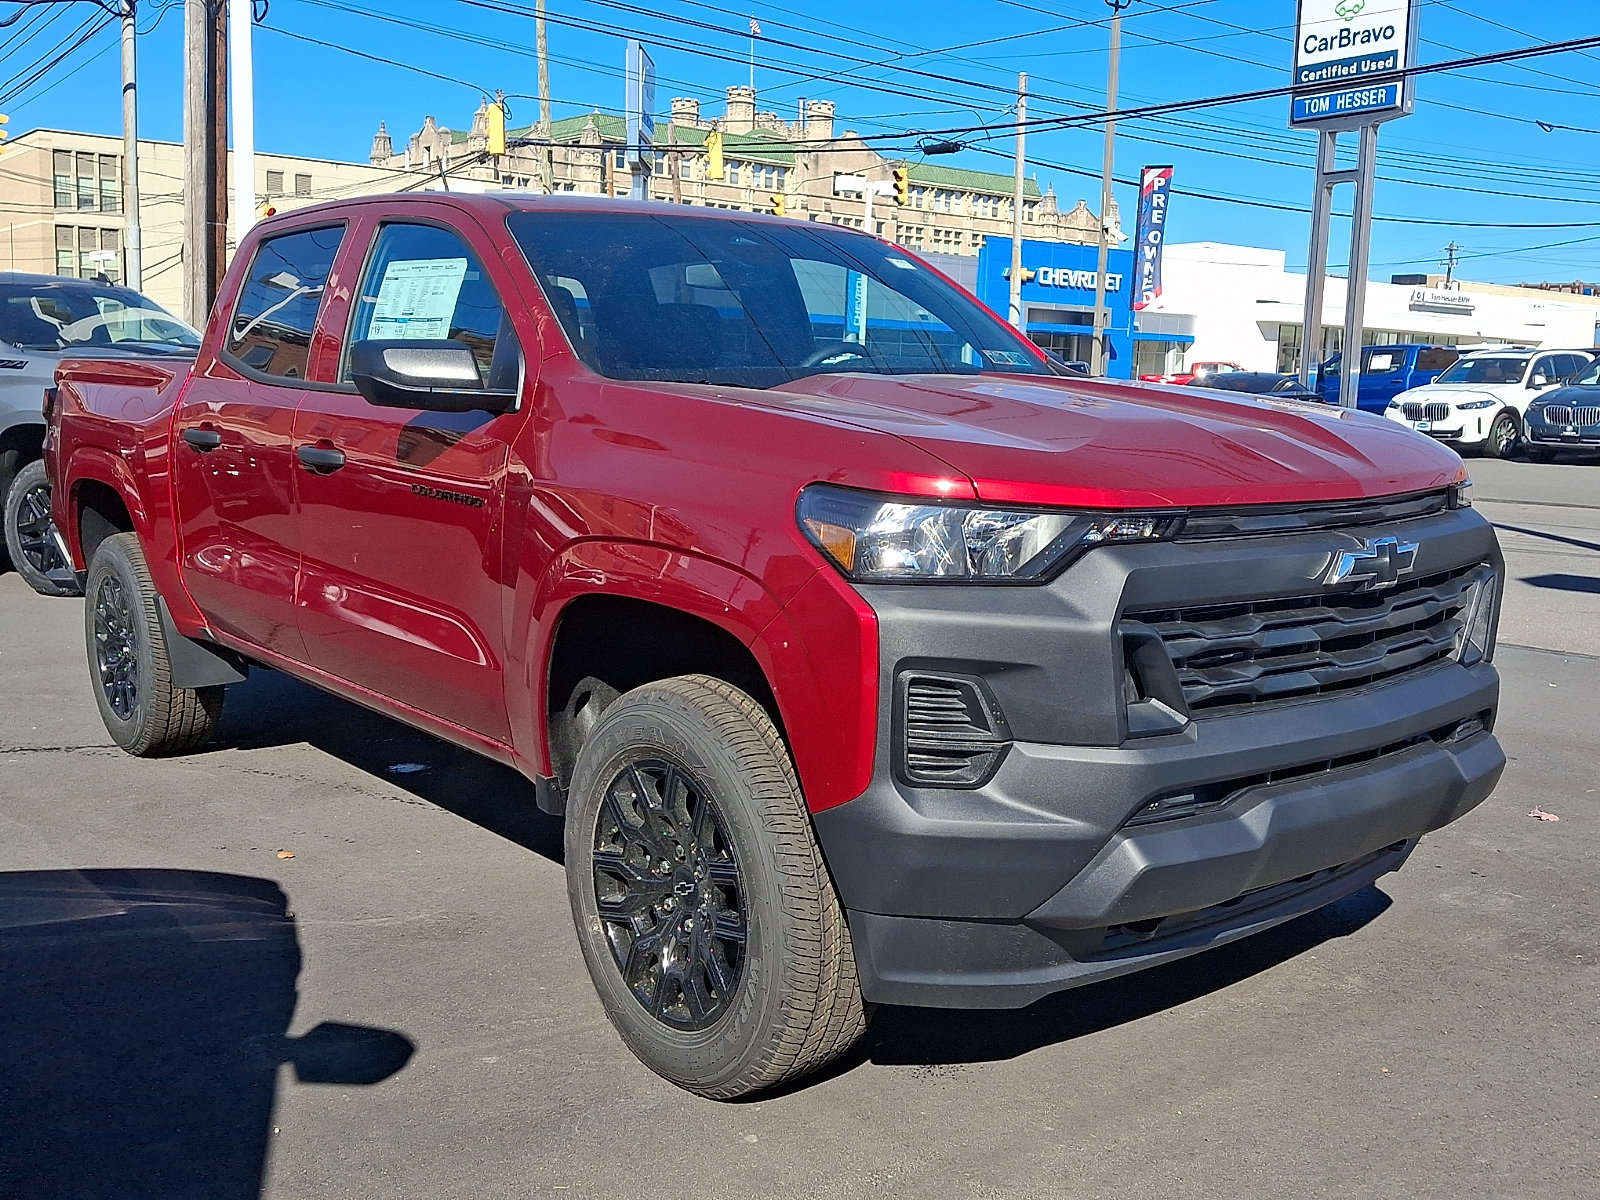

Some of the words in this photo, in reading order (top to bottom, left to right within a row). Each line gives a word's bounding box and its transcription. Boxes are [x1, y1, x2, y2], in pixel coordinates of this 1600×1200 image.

[1304, 25, 1395, 54] CarBravo
[1301, 62, 1357, 82] Certified
[1361, 56, 1394, 72] Used
[1304, 97, 1330, 114] TOM
[1336, 88, 1387, 110] HESSER
[1151, 177, 1166, 224] PRE
[1038, 267, 1123, 291] CHEVROET
[1142, 230, 1161, 304] OWNED
